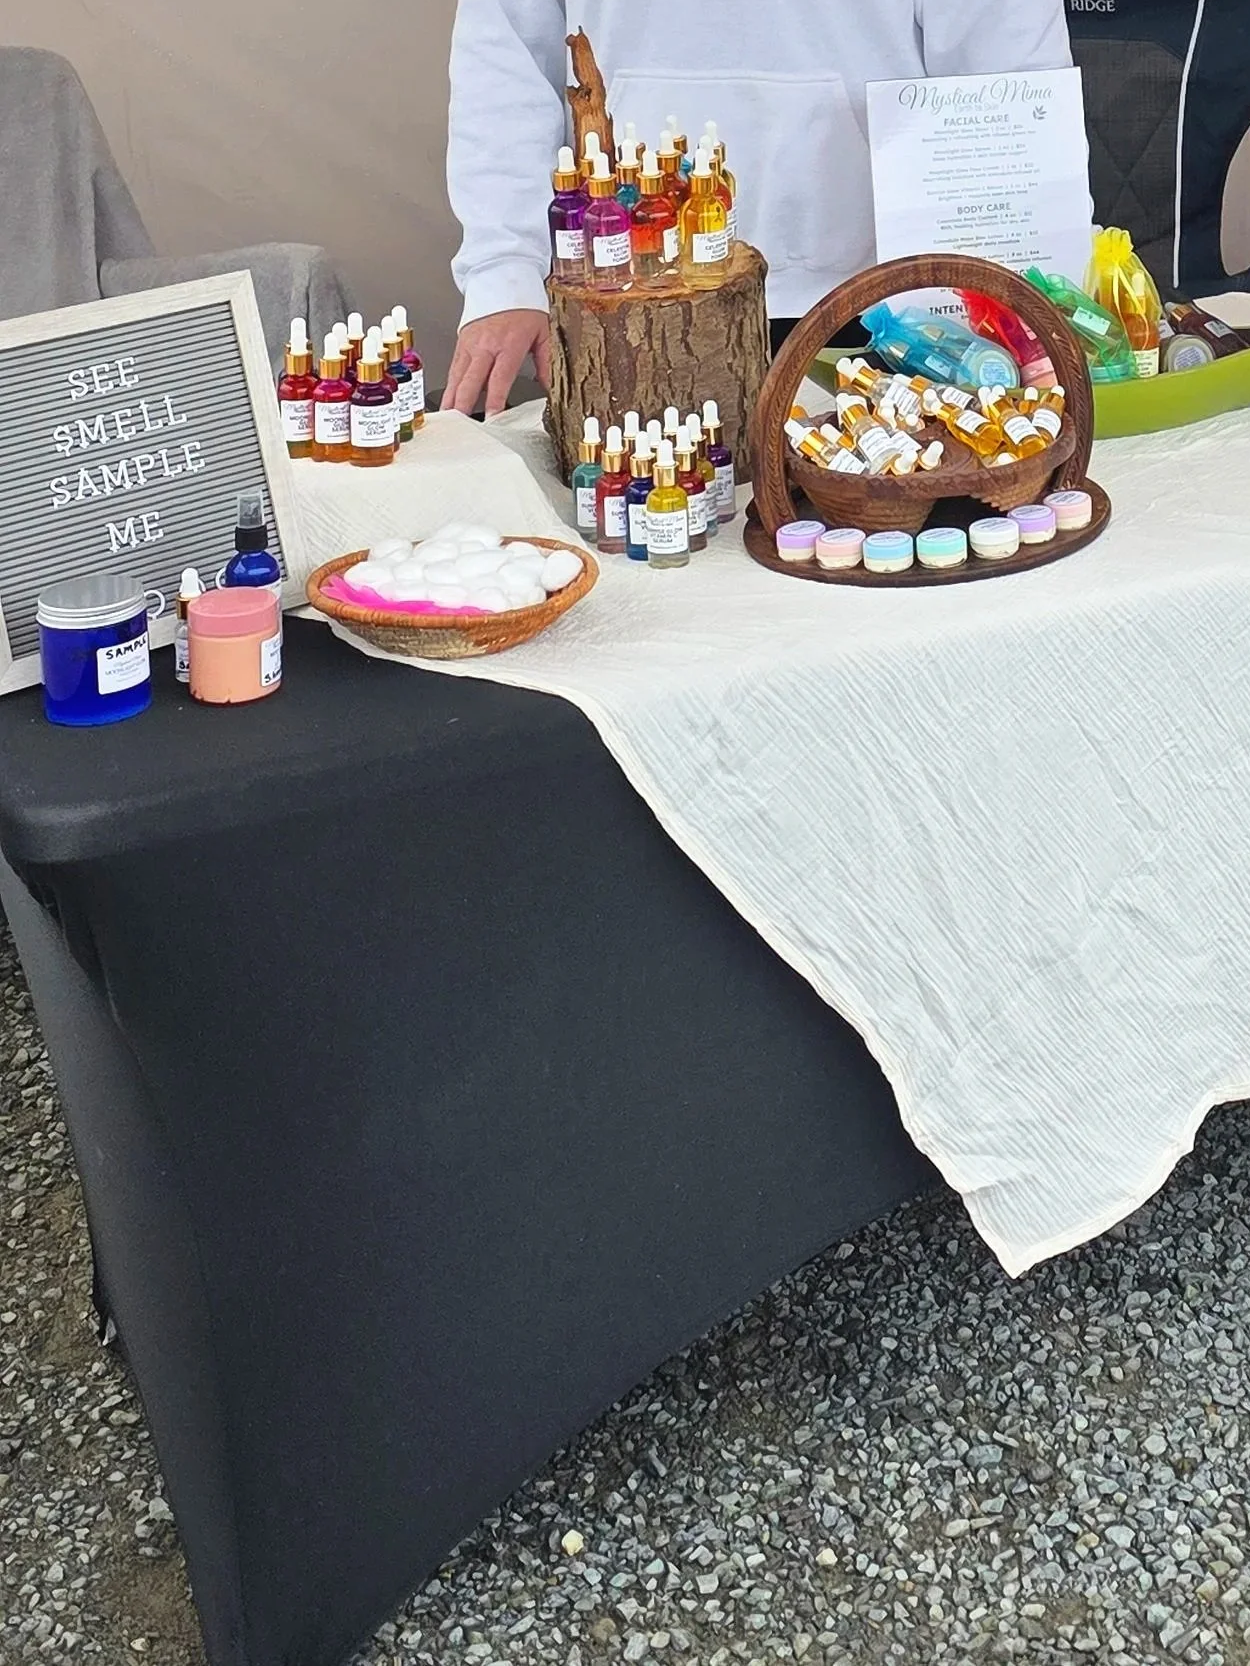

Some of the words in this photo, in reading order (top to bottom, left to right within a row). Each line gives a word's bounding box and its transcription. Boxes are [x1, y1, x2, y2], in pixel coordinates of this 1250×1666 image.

[1071, 0, 1116, 11] RIDGE
[898, 83, 987, 116] Mystical
[989, 77, 1054, 104] Mima
[943, 116, 981, 127] FACIAL
[983, 113, 1010, 124] CARE
[957, 205, 984, 215] BODY
[986, 202, 1012, 213] CARE
[929, 304, 964, 315] INTEN
[67, 355, 141, 401] SEE
[53, 394, 188, 457] SMELL
[49, 441, 206, 510] SAMPLE
[105, 510, 165, 554] ME
[105, 636, 148, 660] SAMPLE
